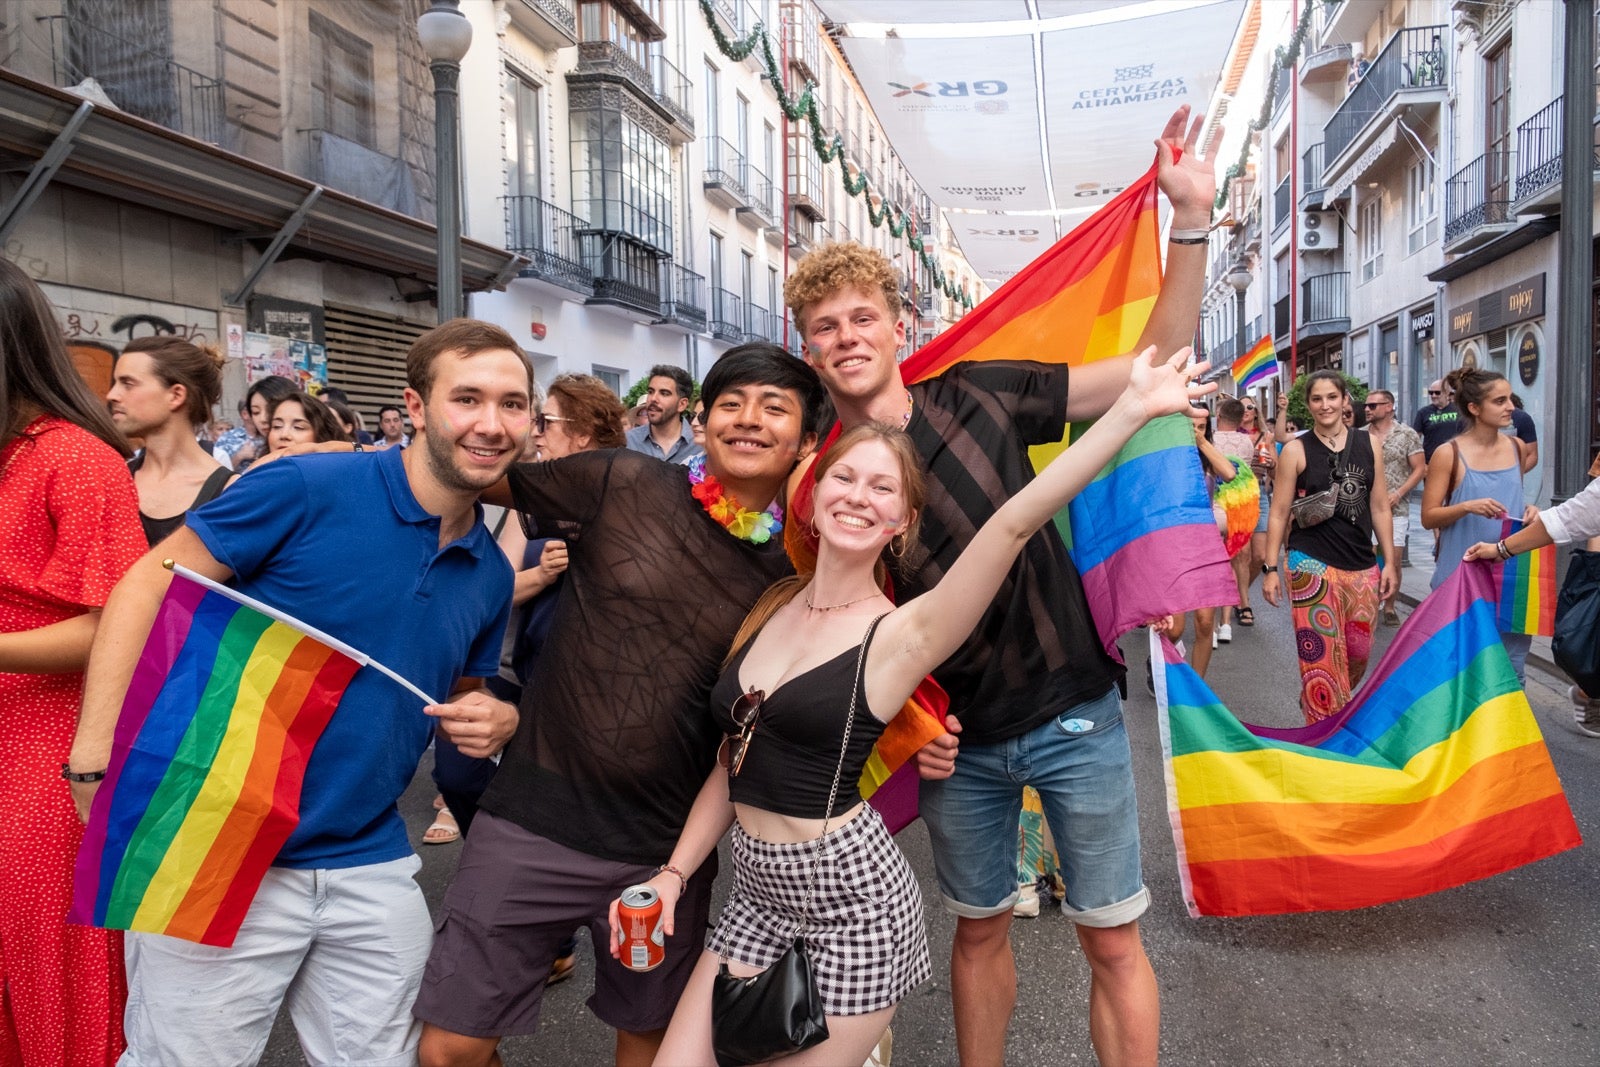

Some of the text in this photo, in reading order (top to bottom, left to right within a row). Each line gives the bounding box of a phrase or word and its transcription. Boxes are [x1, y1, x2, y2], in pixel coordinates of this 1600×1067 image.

[887, 80, 1008, 97] GRX
[1072, 86, 1188, 109] ALHAMBRA
[1079, 77, 1184, 99] CERVEZAS
[1074, 187, 1124, 197] GR
[1509, 285, 1534, 316] mjoy
[1412, 312, 1433, 332] MANGO
[1454, 307, 1473, 334] mjoy
